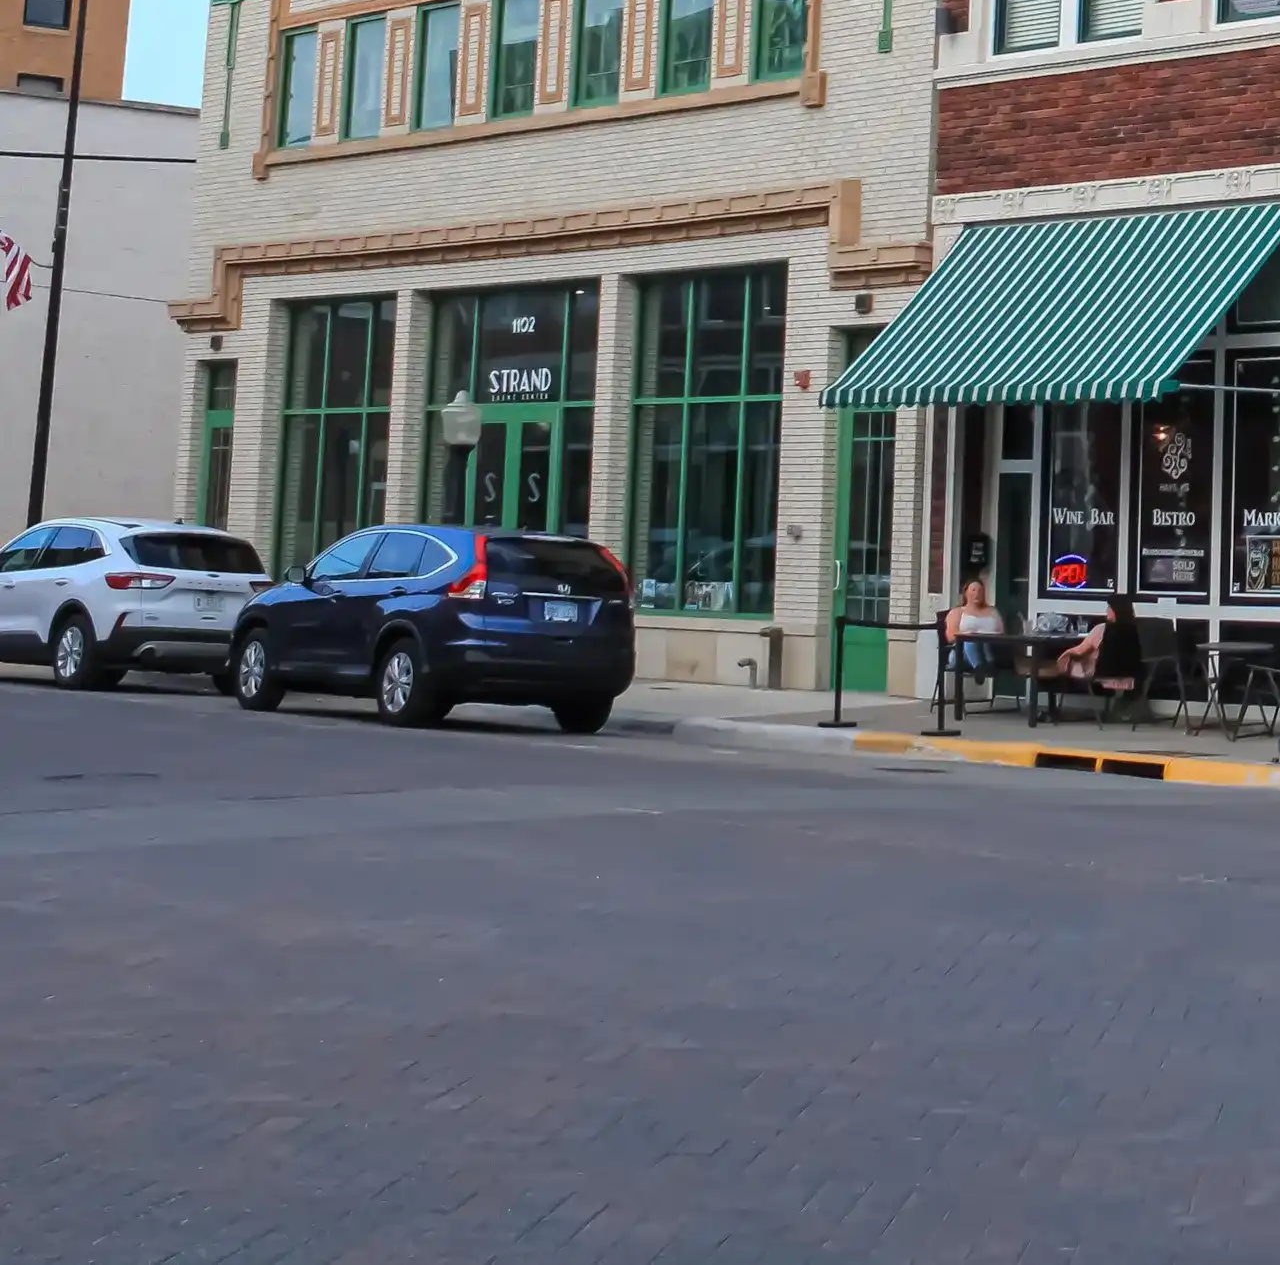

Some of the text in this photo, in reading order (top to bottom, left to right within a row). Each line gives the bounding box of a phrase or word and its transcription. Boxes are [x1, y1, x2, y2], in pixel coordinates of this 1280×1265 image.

[512, 316, 536, 334] 1102
[489, 367, 552, 394] STRAND
[484, 472, 498, 502] S
[528, 473, 541, 503] S
[1051, 564, 1087, 583] OPEN
[1173, 560, 1196, 571] SOLD
